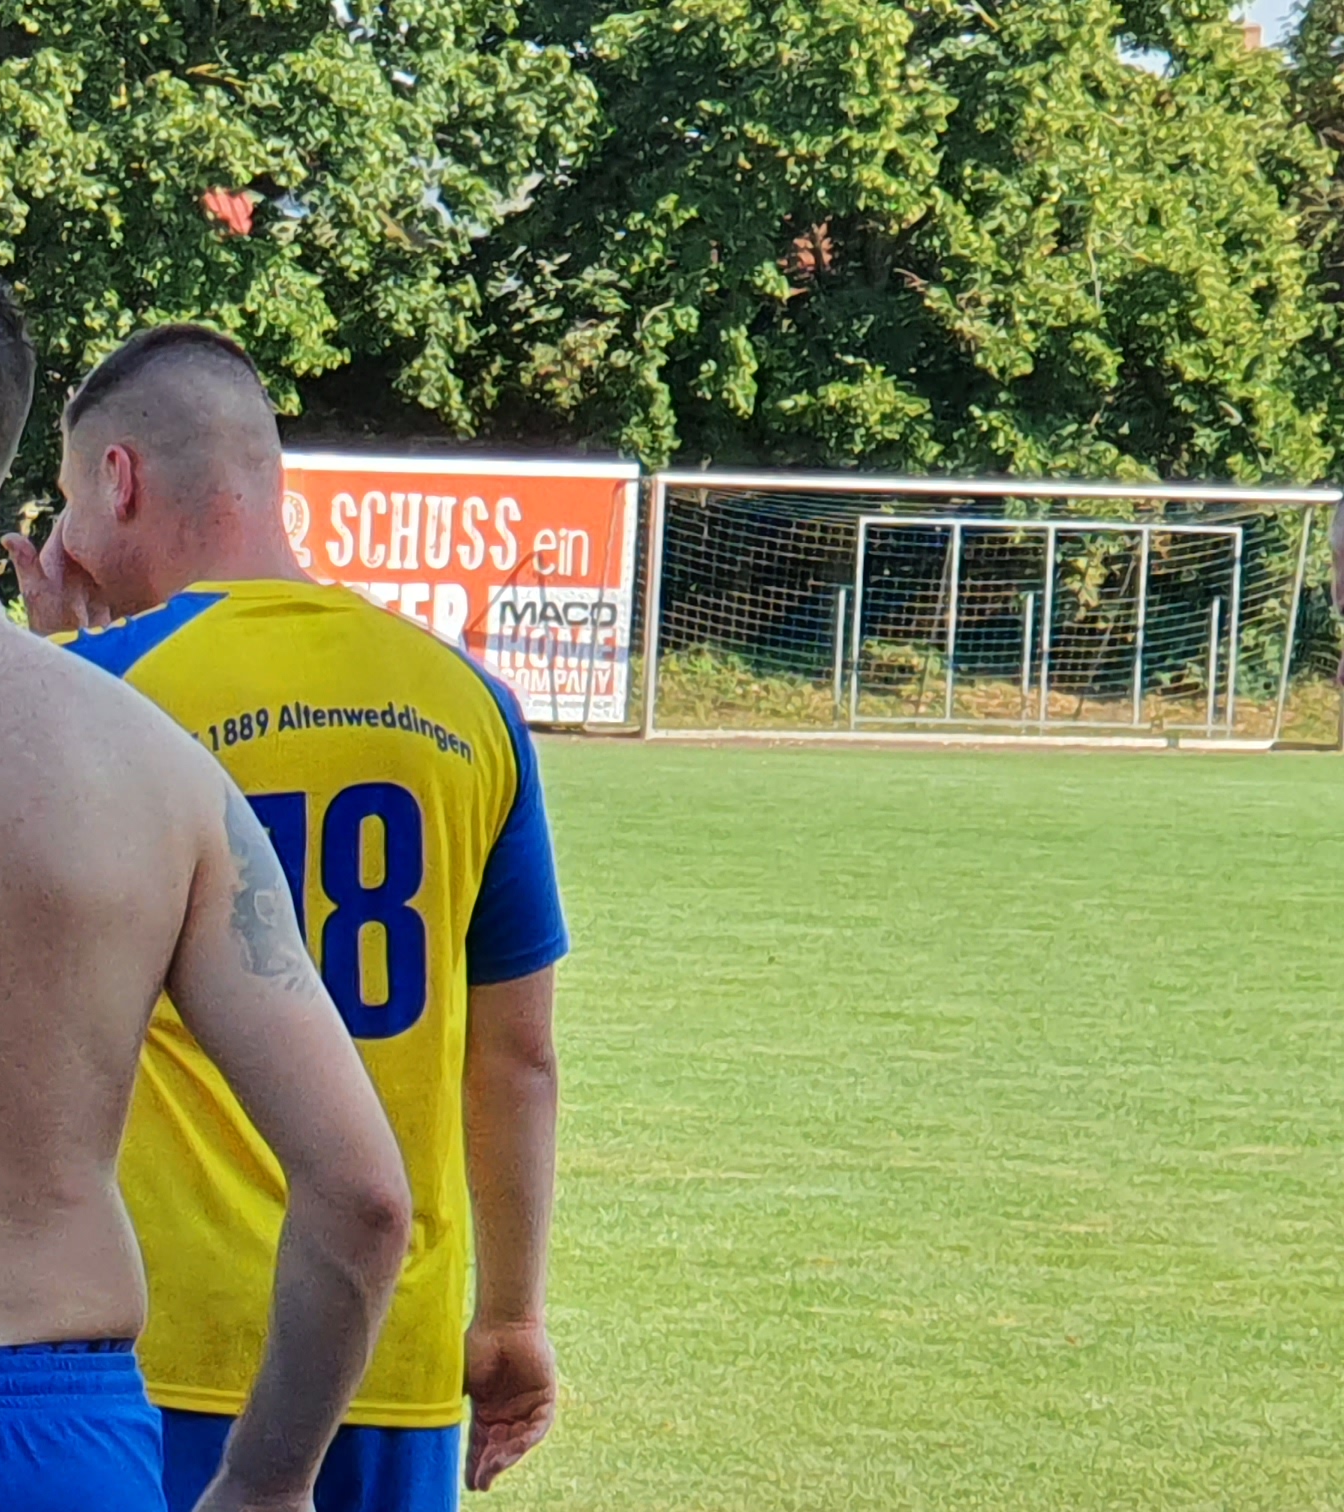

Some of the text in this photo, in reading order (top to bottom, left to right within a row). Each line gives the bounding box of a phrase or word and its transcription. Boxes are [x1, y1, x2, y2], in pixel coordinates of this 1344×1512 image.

[325, 490, 523, 571] SCHUSS
[533, 527, 590, 577] ein
[500, 600, 618, 627] MACO
[208, 700, 473, 765] 1889 Altenweddingen
